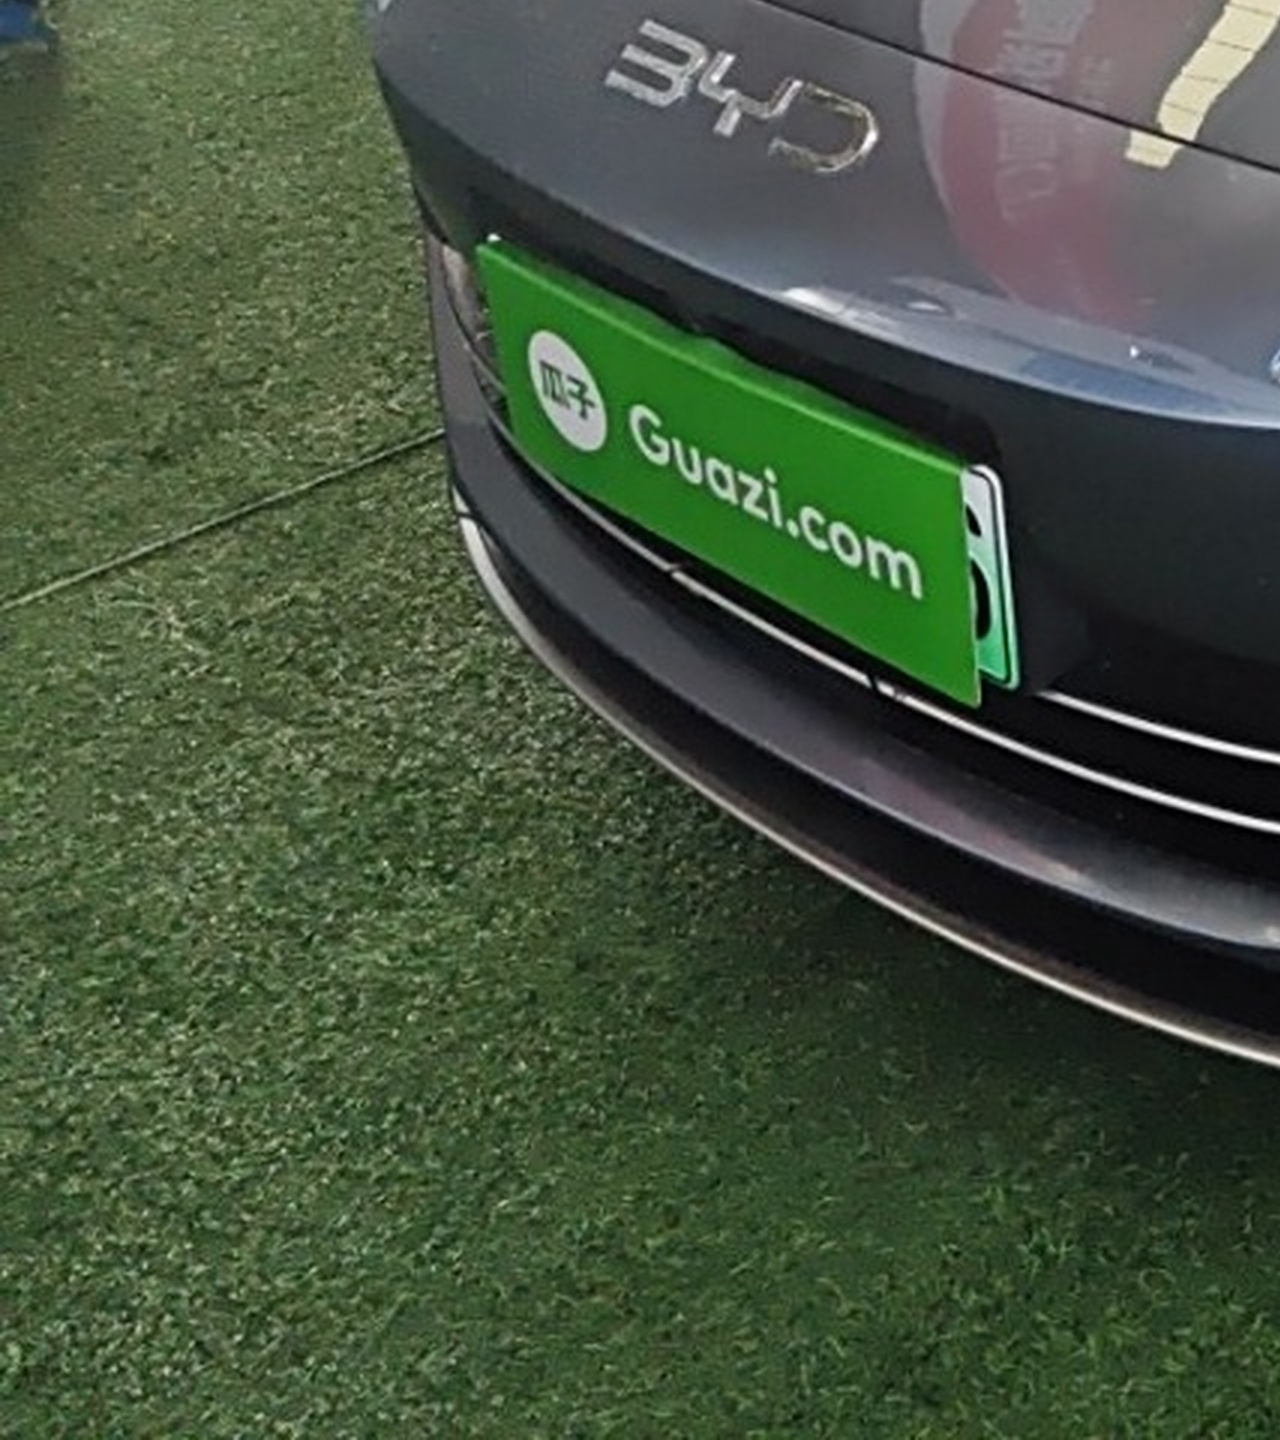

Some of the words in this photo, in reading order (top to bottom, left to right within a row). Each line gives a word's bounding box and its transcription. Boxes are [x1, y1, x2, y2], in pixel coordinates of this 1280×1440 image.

[605, 19, 879, 172] BYD
[538, 359, 597, 420] 瓜子
[628, 404, 923, 599] Guazi.com
